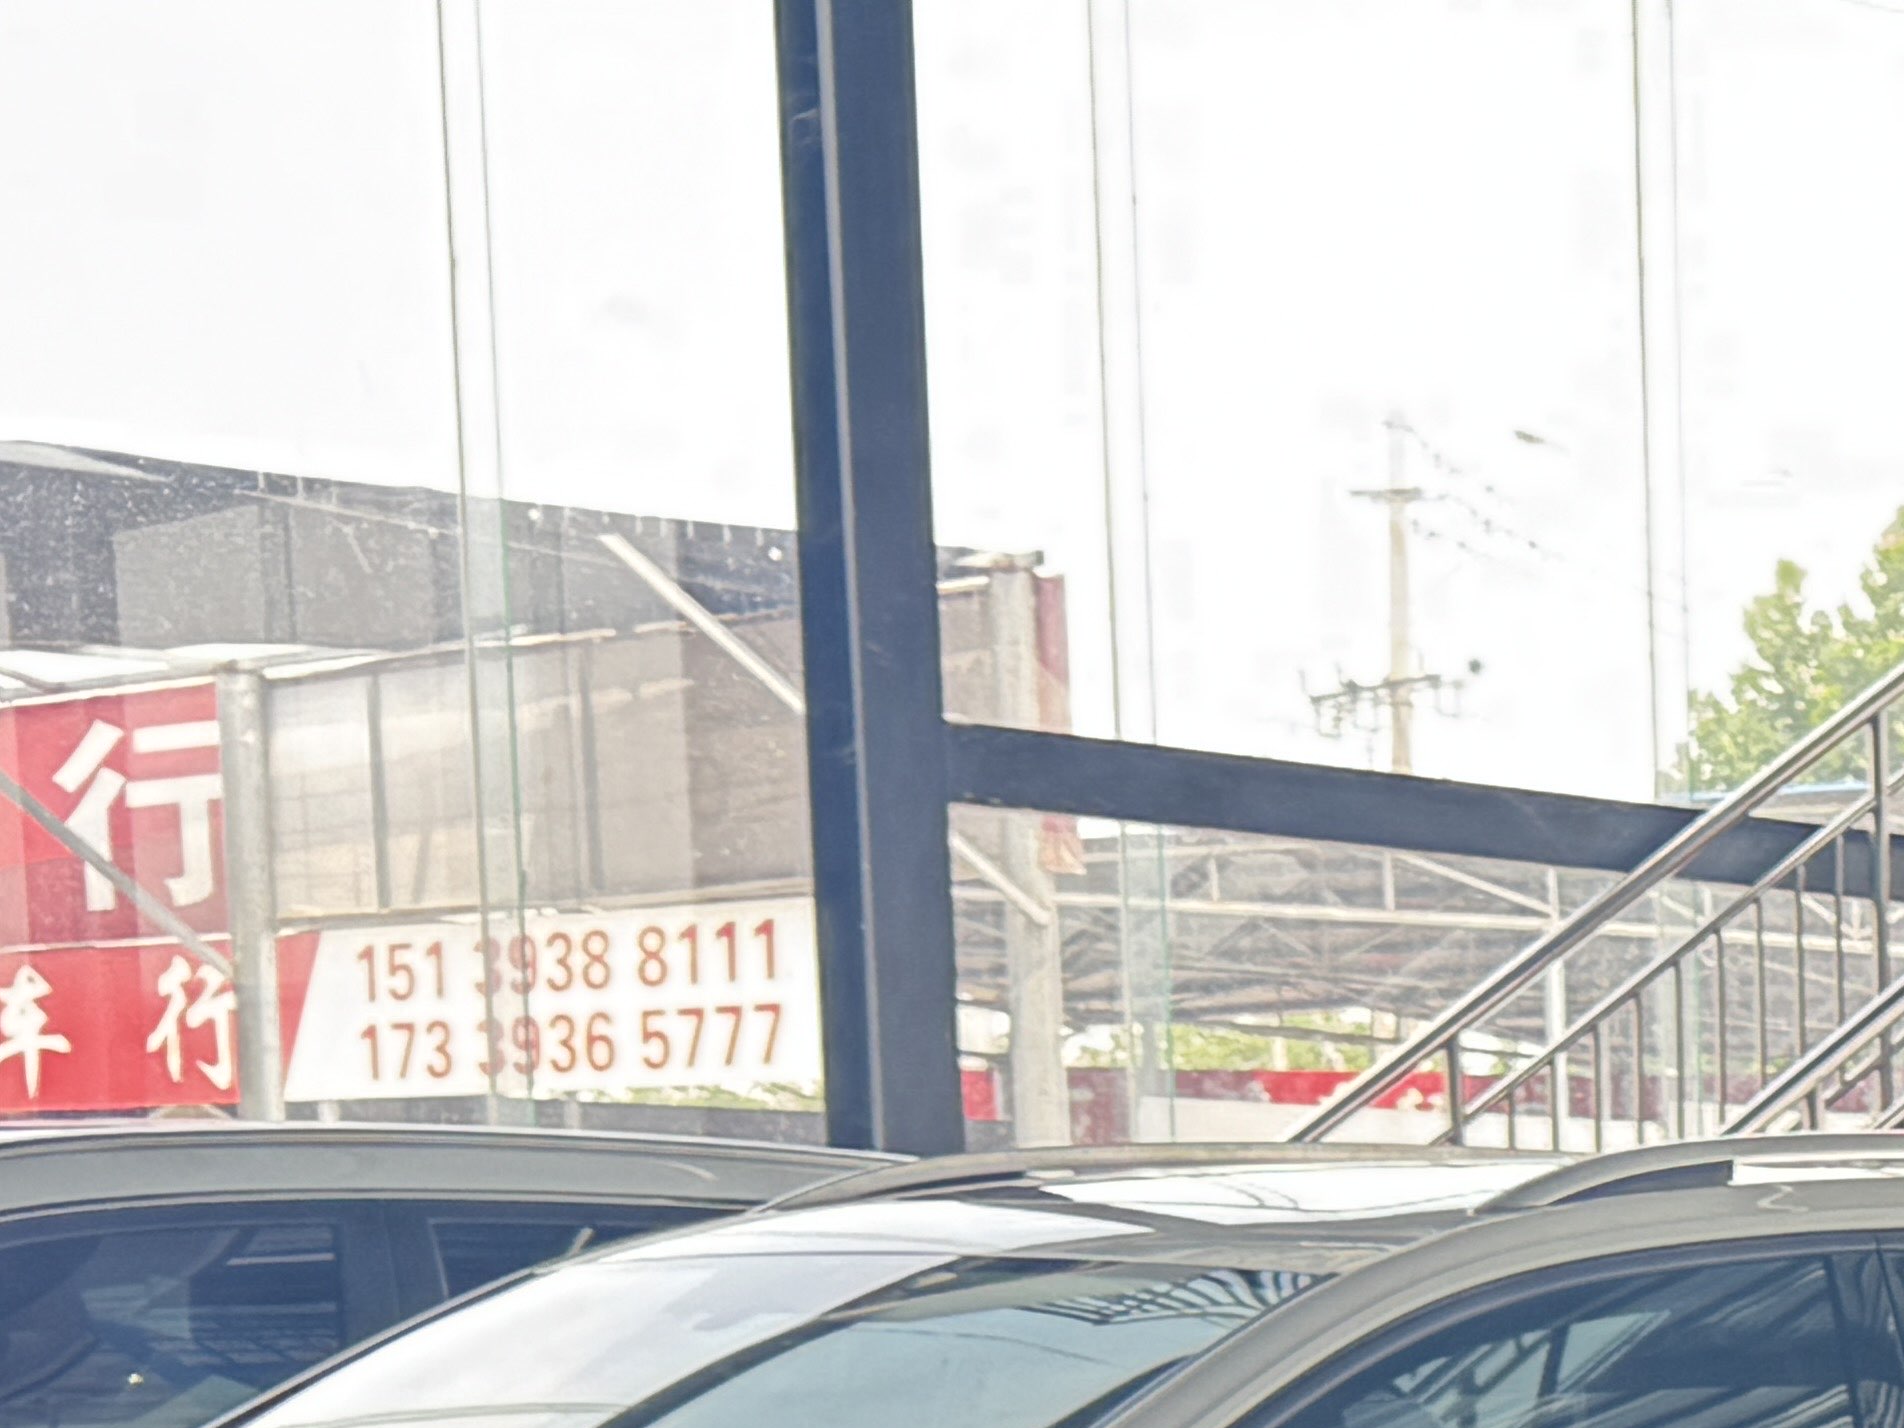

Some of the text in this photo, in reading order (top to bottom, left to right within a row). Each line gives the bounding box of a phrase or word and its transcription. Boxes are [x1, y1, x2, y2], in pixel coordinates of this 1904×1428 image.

[52, 718, 223, 912] 行
[356, 918, 776, 1003] 151 3938 8111
[359, 1003, 782, 1082] 173 3936 5777
